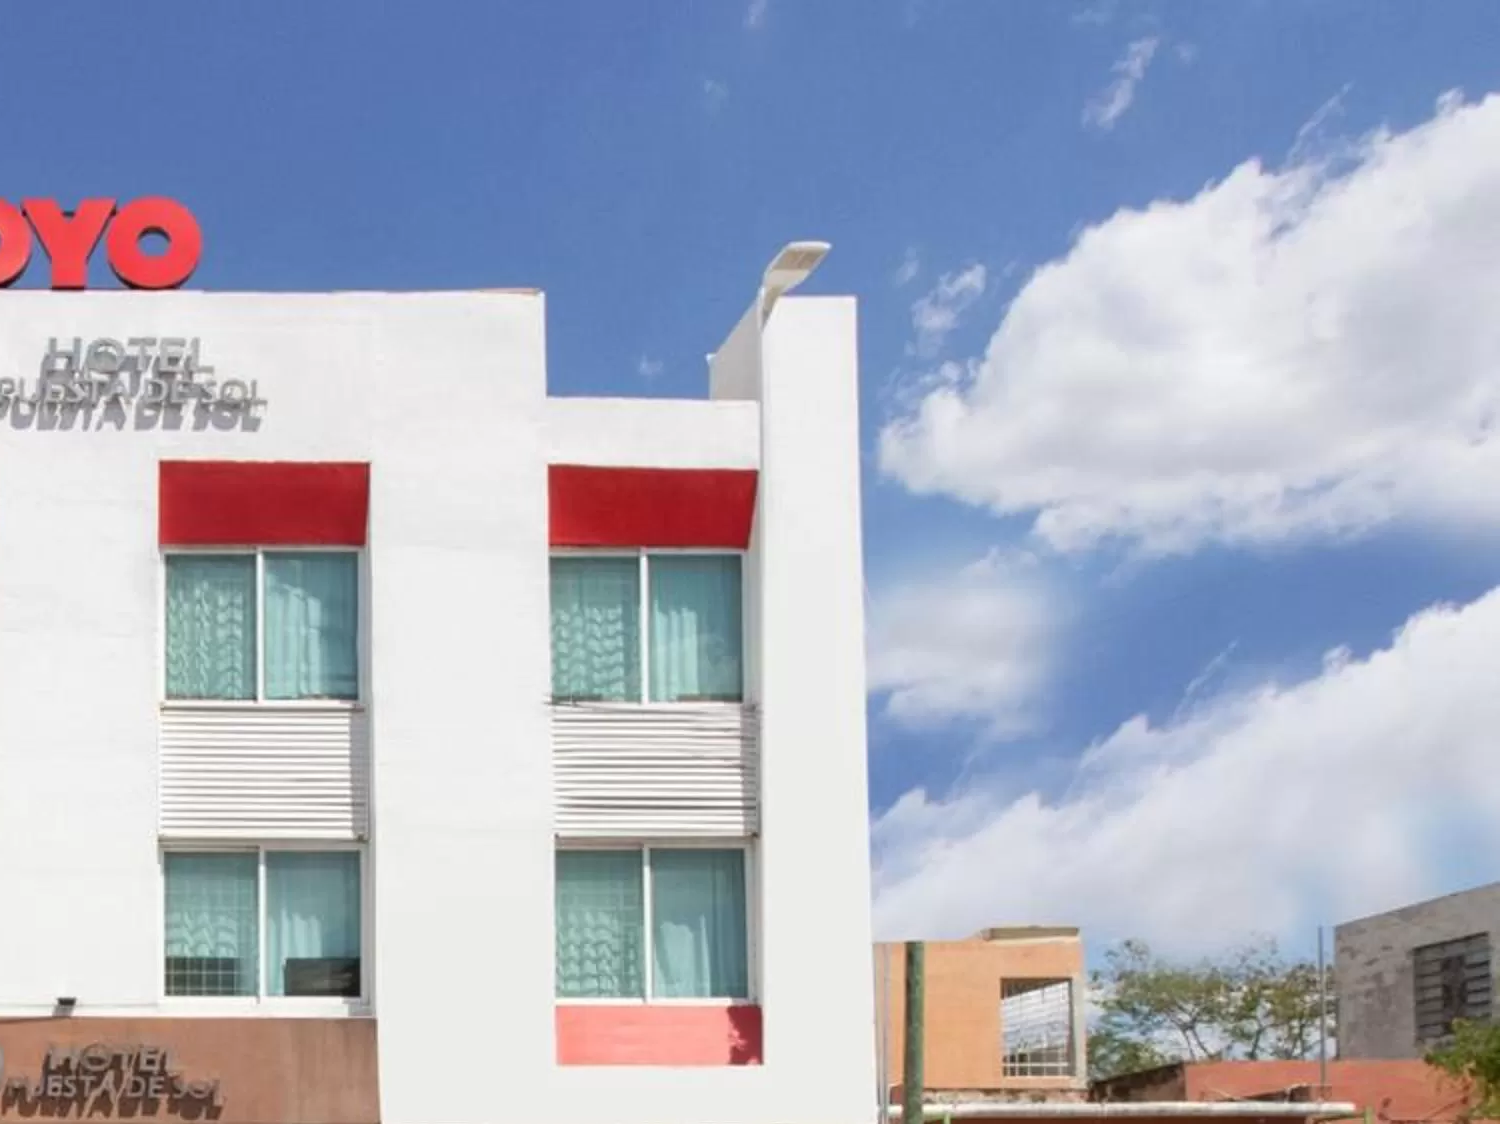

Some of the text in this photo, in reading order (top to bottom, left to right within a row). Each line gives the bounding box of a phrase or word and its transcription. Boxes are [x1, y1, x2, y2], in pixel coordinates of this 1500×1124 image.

[47, 337, 215, 374] HOTEL
[144, 379, 194, 405] DE
[200, 379, 268, 406] SOL
[47, 1043, 180, 1072] HOTEL
[7, 1074, 227, 1106] PUESTA DE SOL
